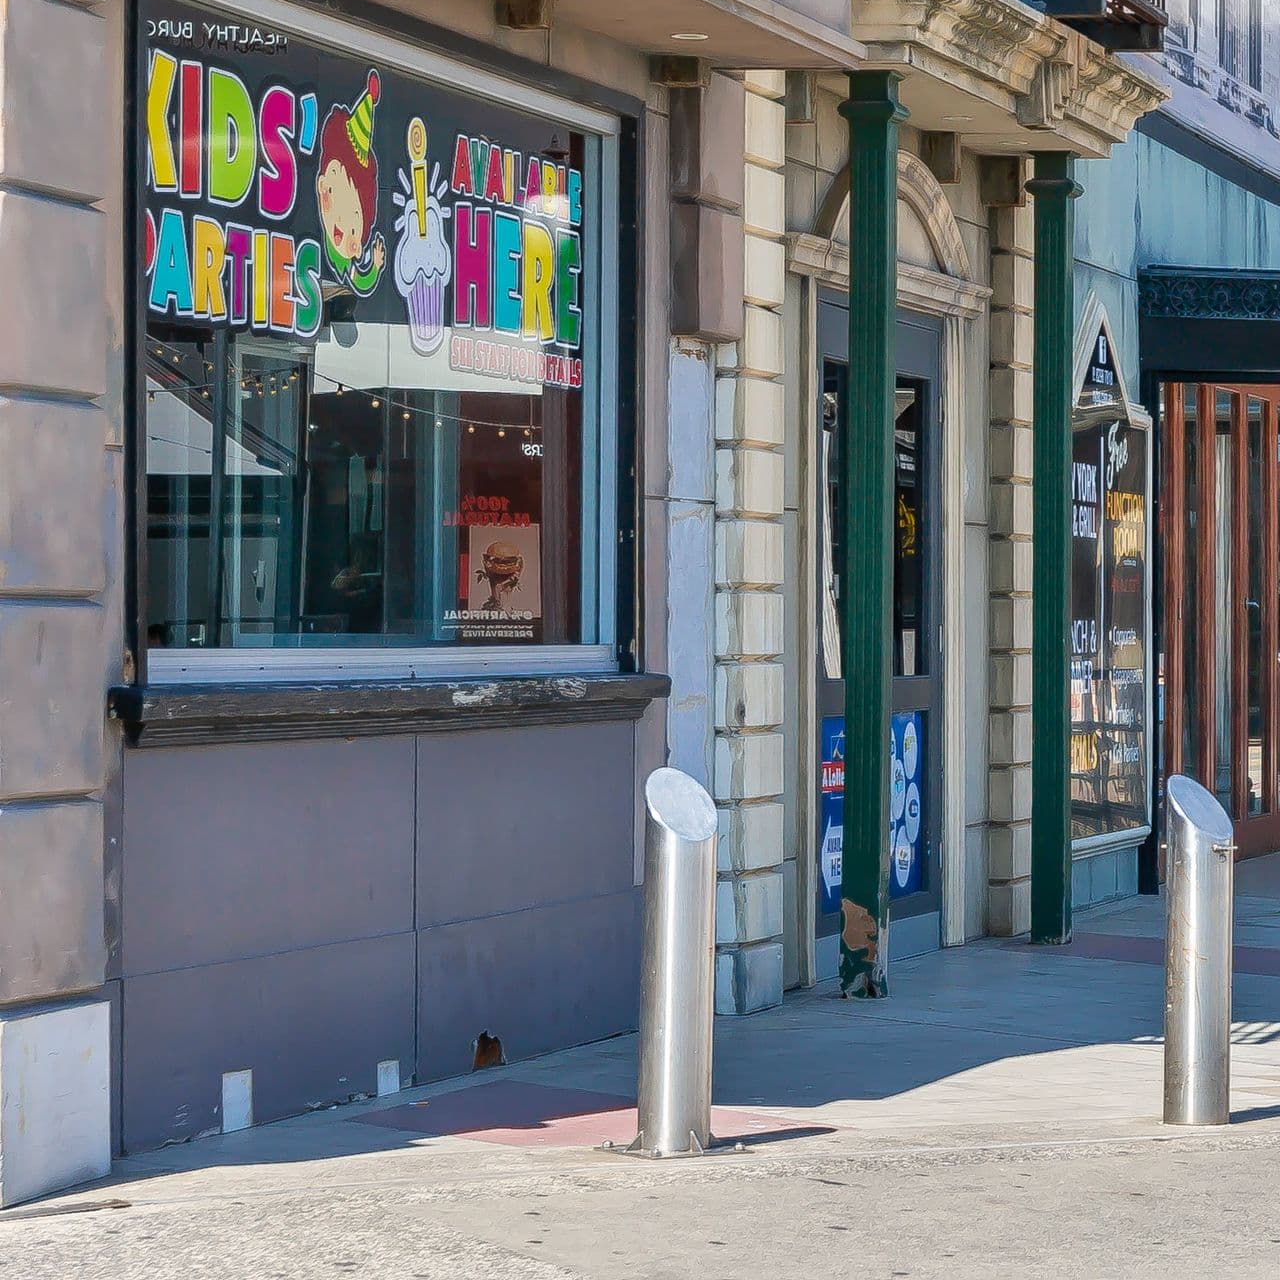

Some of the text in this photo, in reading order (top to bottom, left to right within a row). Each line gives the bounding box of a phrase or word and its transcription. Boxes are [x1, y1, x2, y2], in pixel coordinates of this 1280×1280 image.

[451, 133, 582, 226] AVAILABLE
[146, 208, 322, 338] ARTIES
[453, 201, 582, 350] HERE
[536, 352, 582, 389] DETAILS
[1106, 490, 1144, 524] FUNCTION
[1112, 525, 1138, 557] ROOM
